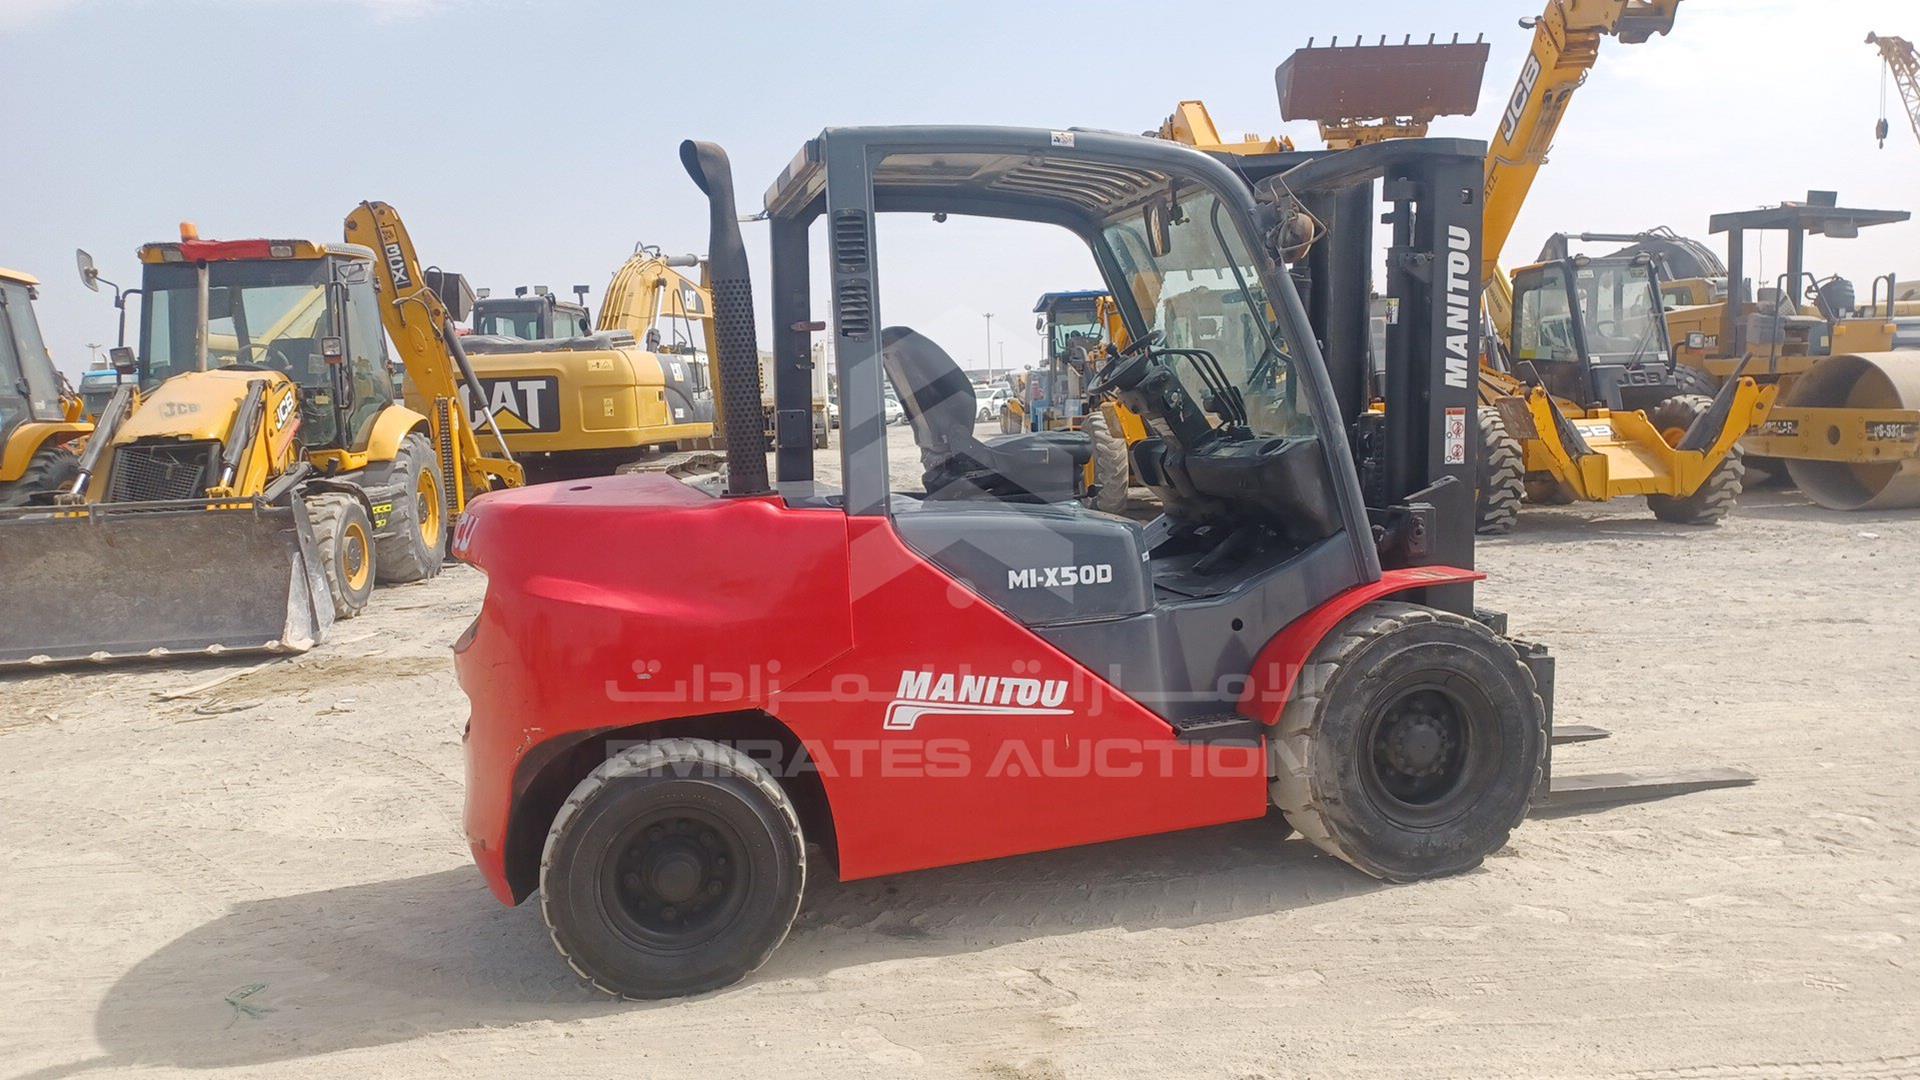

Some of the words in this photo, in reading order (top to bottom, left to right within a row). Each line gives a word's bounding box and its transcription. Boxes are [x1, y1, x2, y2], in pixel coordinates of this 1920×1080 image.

[1504, 54, 1541, 142] JCB
[1445, 225, 1472, 389] MANITOU
[1616, 371, 1662, 386] JCB
[162, 401, 200, 419] JCB
[275, 389, 294, 430] JCB
[459, 380, 547, 430] CAT
[1007, 564, 1113, 590] MI-X50D
[895, 669, 1069, 708] MANITOU
